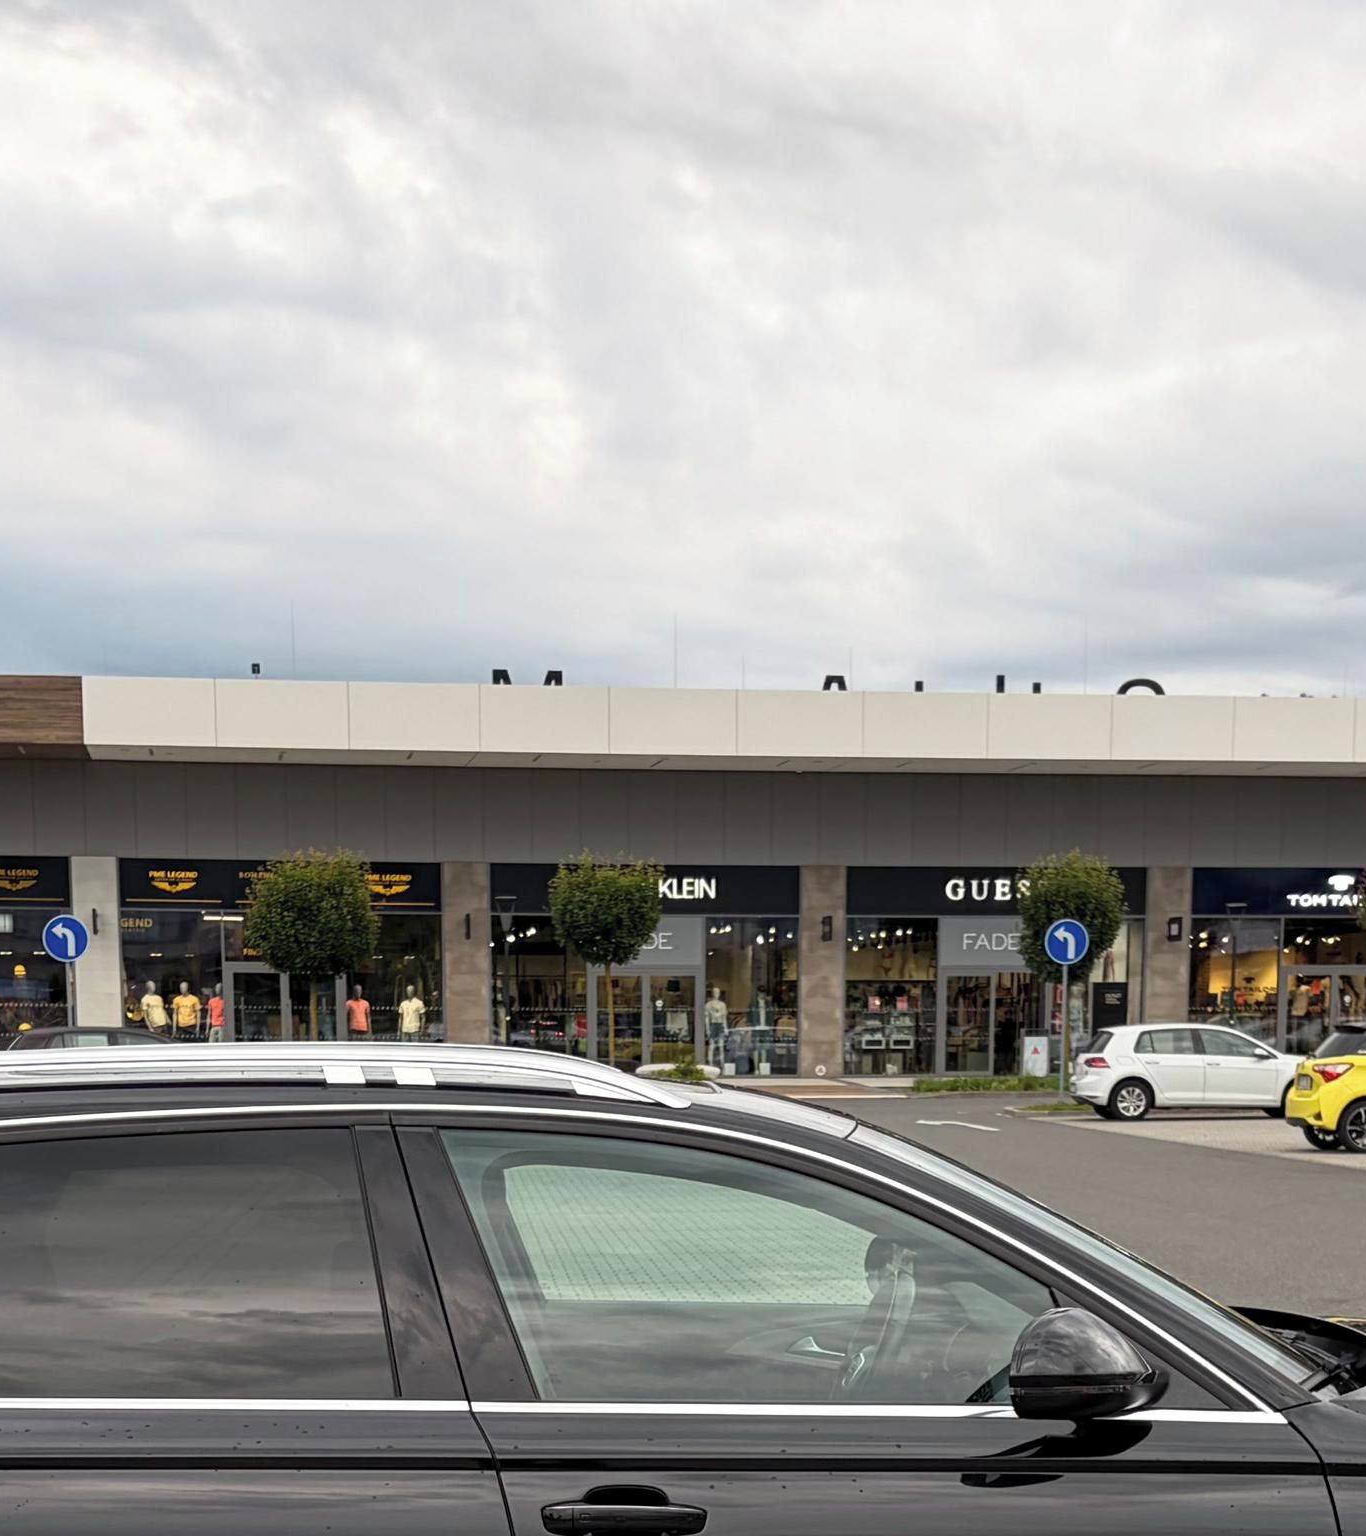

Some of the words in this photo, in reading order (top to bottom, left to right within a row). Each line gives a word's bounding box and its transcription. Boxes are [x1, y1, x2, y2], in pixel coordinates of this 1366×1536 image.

[7, 868, 39, 877] LEGEND
[148, 870, 166, 878] PME
[167, 870, 198, 878] LEGEND
[382, 874, 412, 882] LEGEND
[658, 877, 716, 899] KLEIN
[944, 879, 1033, 901] GUES
[1286, 893, 1327, 908] TOM
